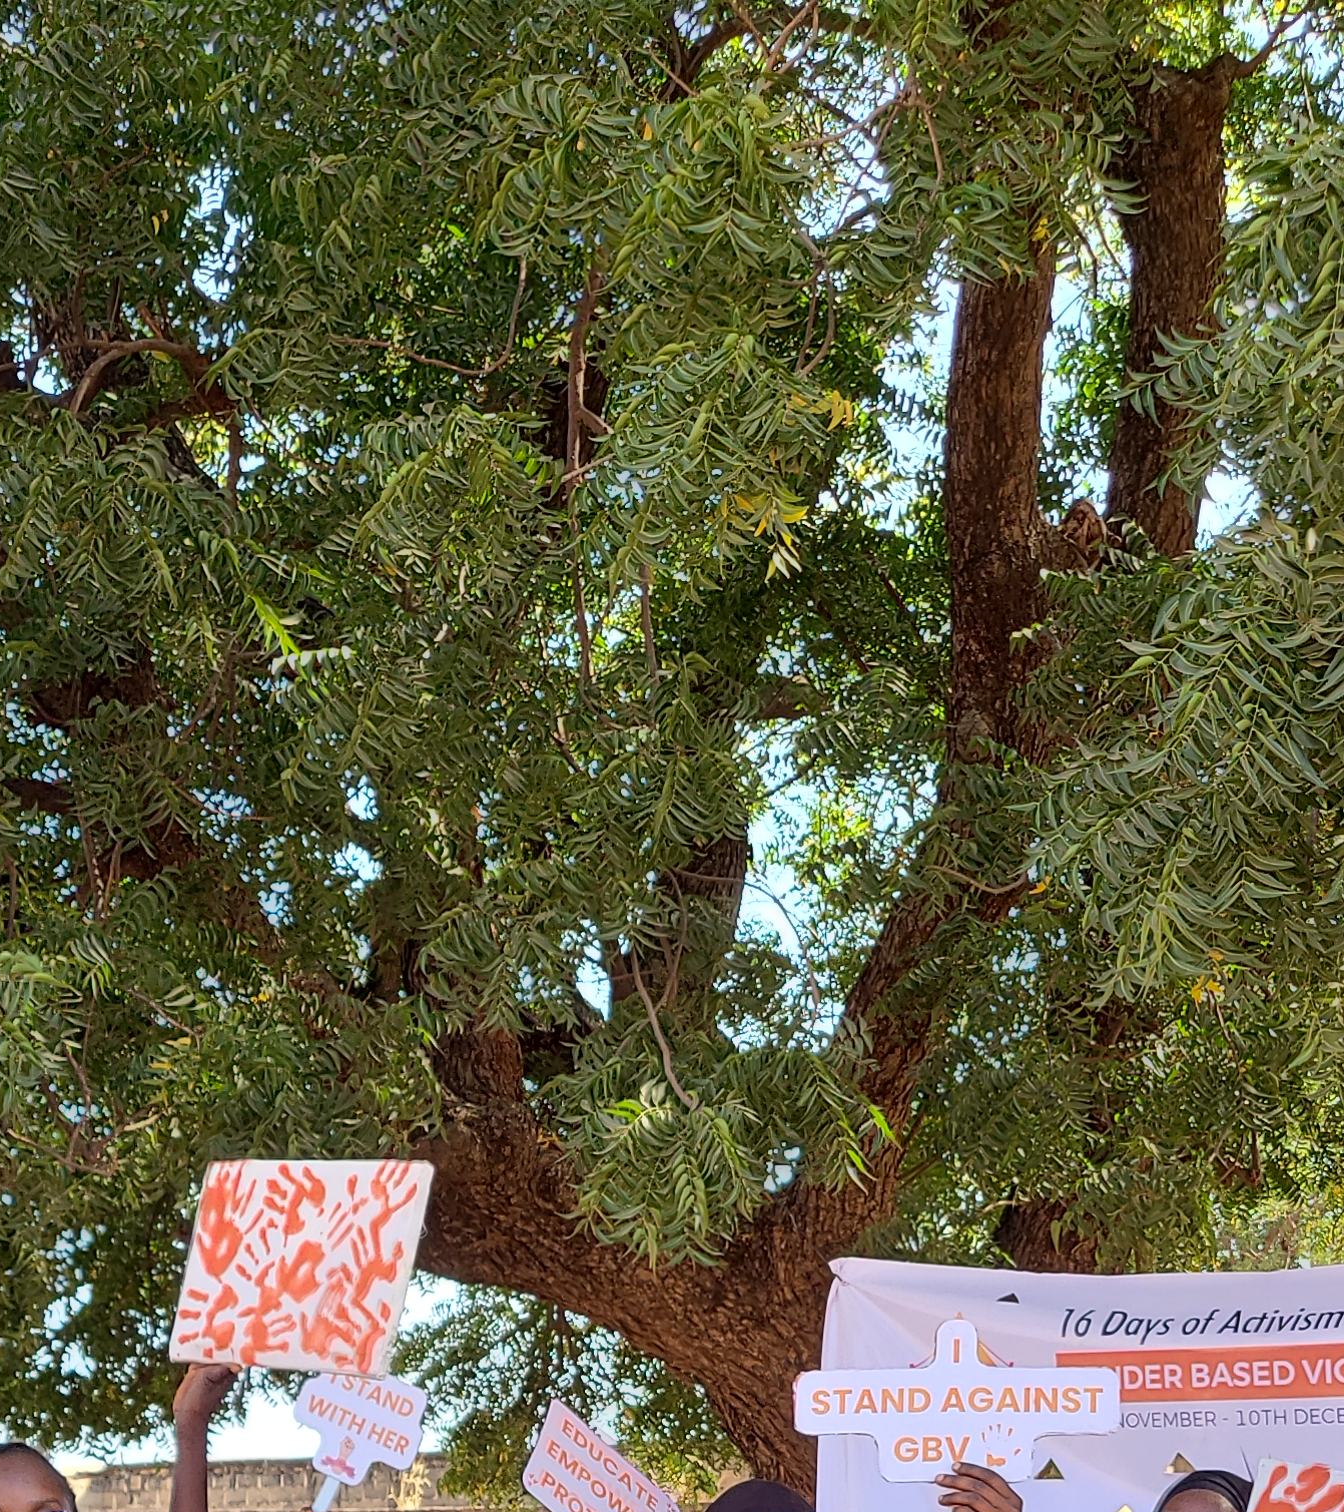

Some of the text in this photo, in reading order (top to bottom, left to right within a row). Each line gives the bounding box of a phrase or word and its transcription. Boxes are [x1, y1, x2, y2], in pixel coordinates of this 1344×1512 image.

[1060, 1307, 1093, 1338] 16
[1101, 1309, 1174, 1345] Days
[1181, 1308, 1221, 1336] of
[952, 1338, 961, 1364] I
[1117, 1364, 1184, 1391] DER
[1191, 1359, 1296, 1389] BASED
[341, 1374, 414, 1417] STAND
[811, 1386, 1105, 1415] STAND AGAINST
[308, 1394, 410, 1456] WITH HER
[1235, 1409, 1288, 1428] 10TH
[893, 1436, 971, 1463] GBV
